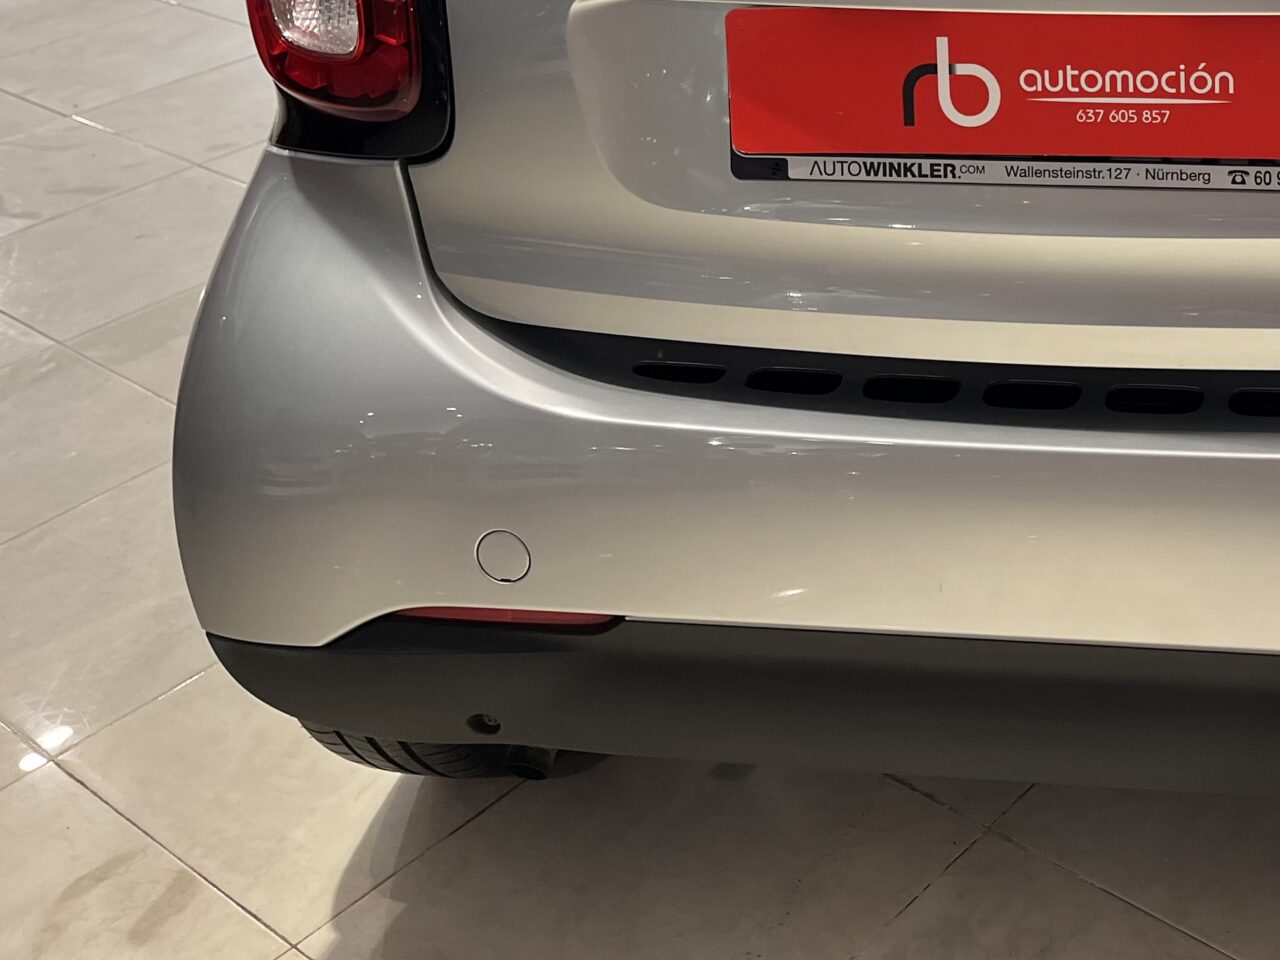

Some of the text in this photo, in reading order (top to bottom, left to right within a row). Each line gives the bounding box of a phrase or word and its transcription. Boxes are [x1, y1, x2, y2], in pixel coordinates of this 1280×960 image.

[1019, 62, 1234, 94] automoción
[1076, 109, 1170, 123] 637 605 857
[1145, 168, 1211, 184] Nürnberg
[1254, 171, 1272, 186] 60
